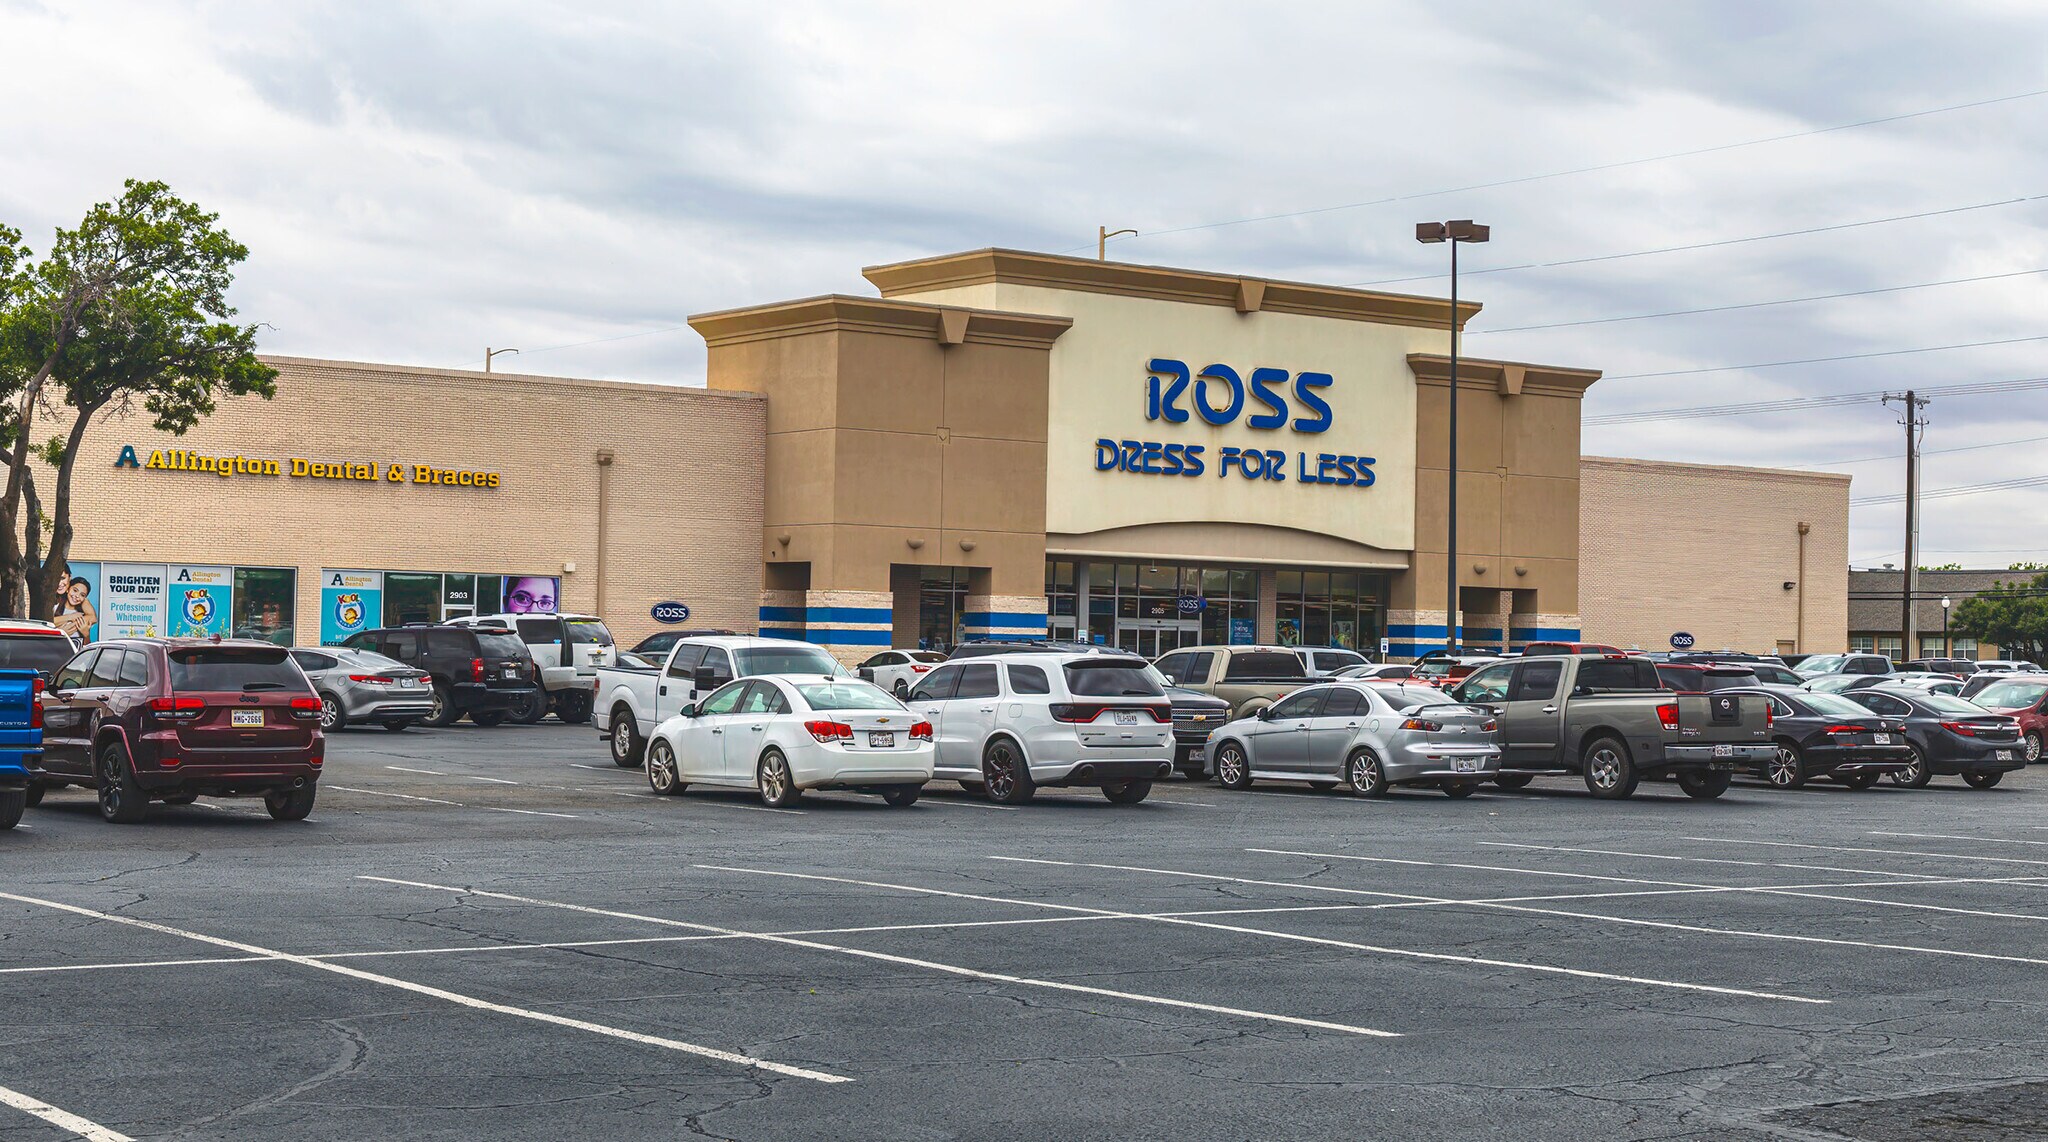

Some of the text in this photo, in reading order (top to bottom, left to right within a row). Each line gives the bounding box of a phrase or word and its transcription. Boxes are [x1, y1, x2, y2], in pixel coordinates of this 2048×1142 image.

[1145, 358, 1333, 433] ROSS
[1095, 438, 1376, 487] DRESS FOR LESS
[146, 450, 281, 477] Allington
[290, 458, 380, 481] Dental
[387, 464, 405, 482] &
[412, 465, 500, 487] Braces
[109, 575, 160, 585] BRIGHTEN
[109, 585, 160, 594] YOUR DAY!
[185, 589, 209, 600] KOOL
[337, 594, 360, 604] KOOL
[110, 602, 157, 612] Professional
[1179, 600, 1198, 609] ROSS
[115, 612, 153, 623] Whitening
[656, 607, 686, 618] ROSS
[1673, 636, 1692, 645] ROSS
